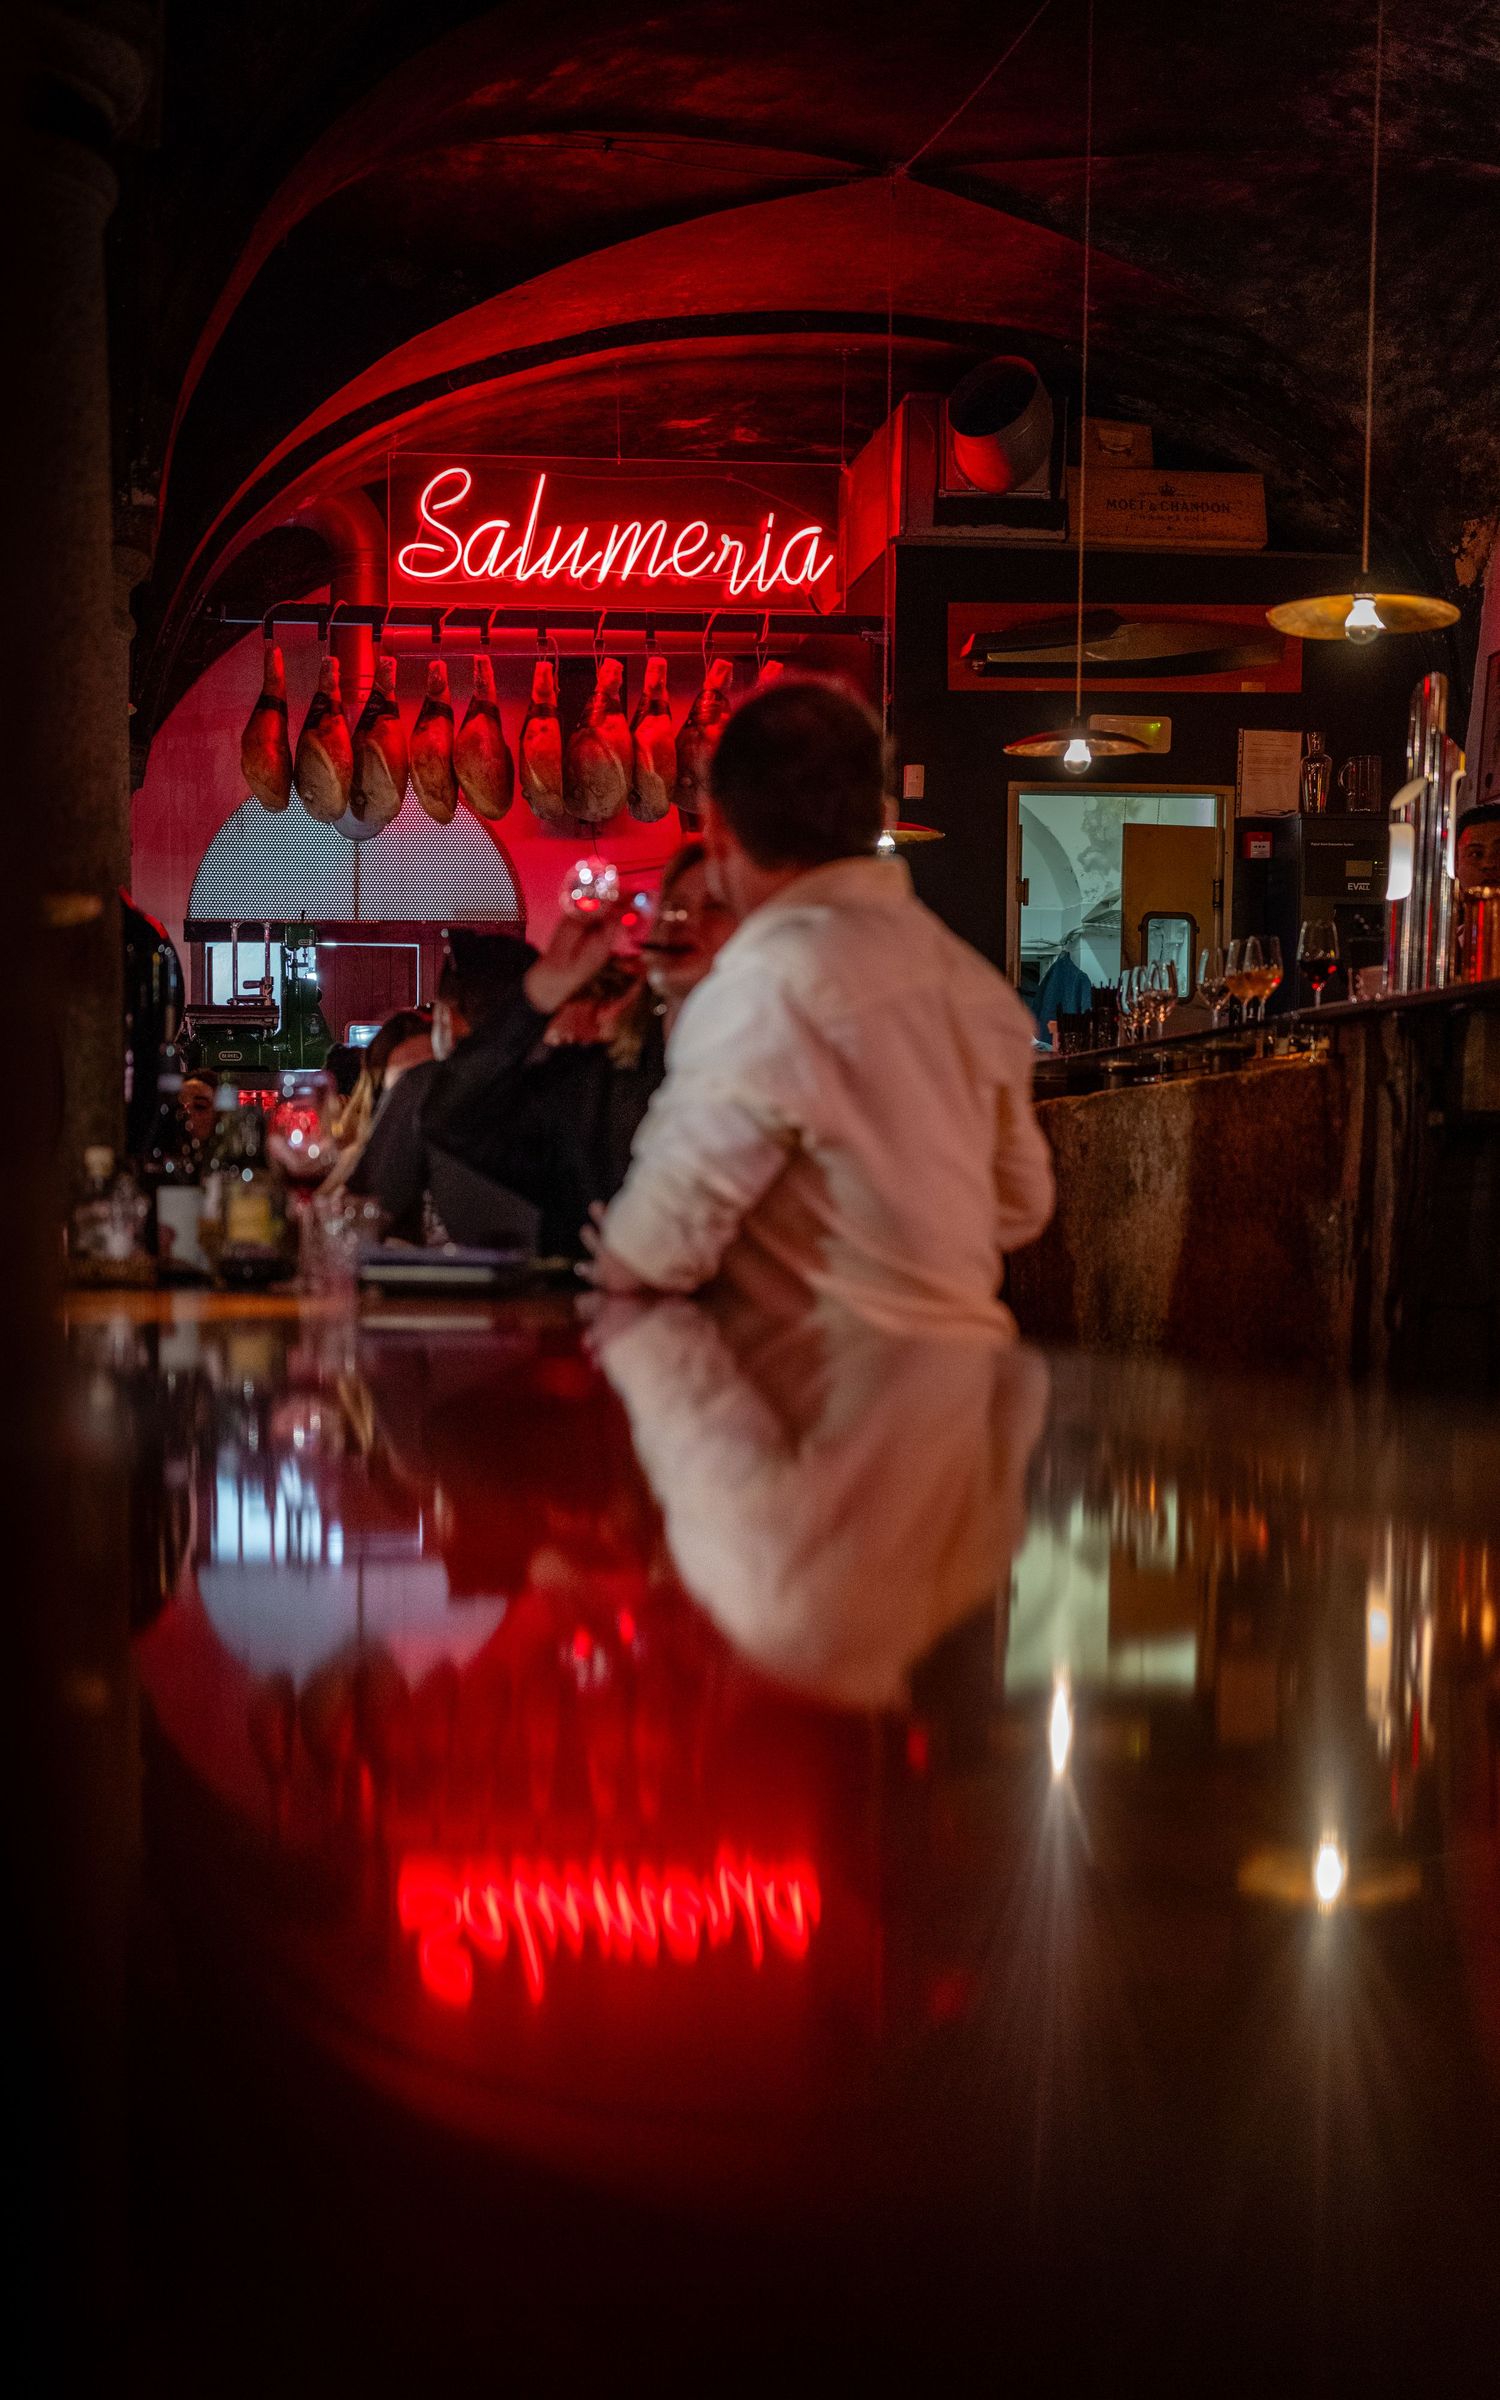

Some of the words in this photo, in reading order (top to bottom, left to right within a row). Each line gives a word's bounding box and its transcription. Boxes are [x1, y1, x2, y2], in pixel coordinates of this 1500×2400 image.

[398, 466, 834, 595] Salumeria
[1148, 501, 1158, 512] &
[1160, 500, 1231, 513] CHANDON
